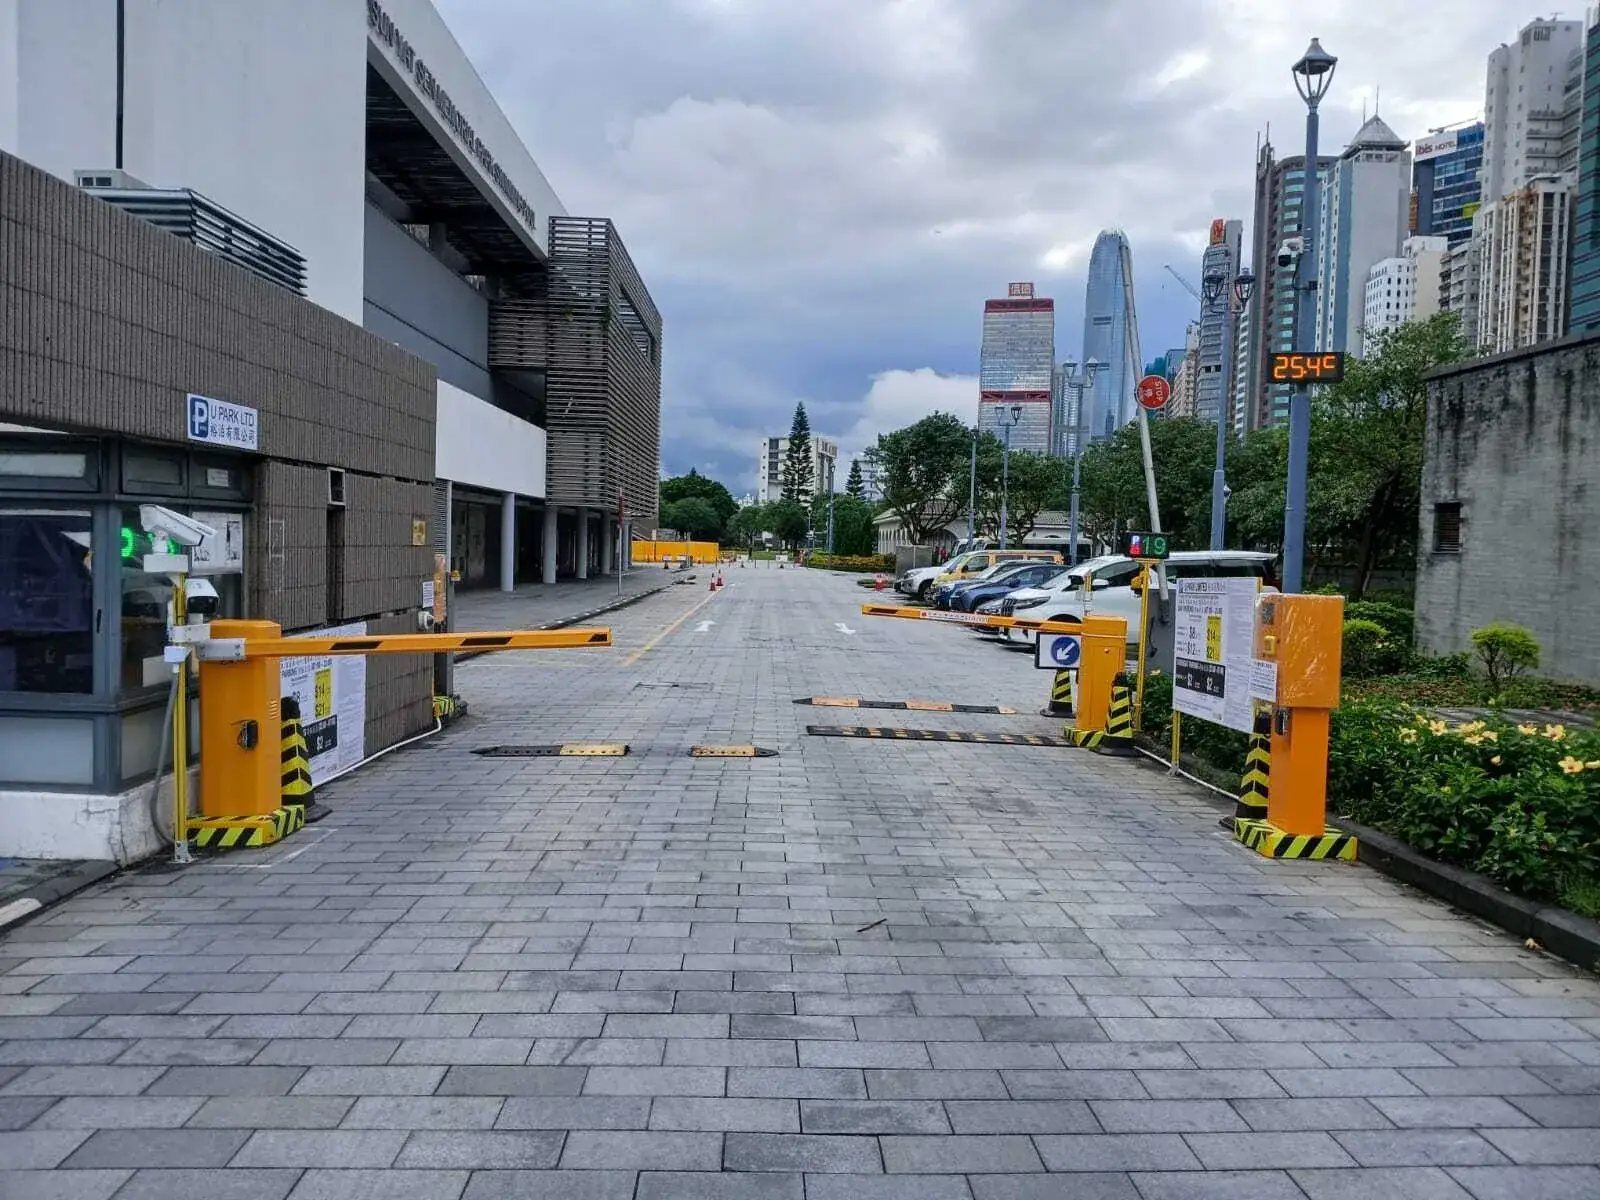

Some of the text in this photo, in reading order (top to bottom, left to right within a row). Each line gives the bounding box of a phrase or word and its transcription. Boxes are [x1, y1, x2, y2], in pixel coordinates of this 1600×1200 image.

[1415, 140, 1456, 156] ibis HOTEL
[1154, 380, 1164, 402] STOP
[210, 404, 254, 427] U PARK LTD
[1142, 535, 1166, 555] 19
